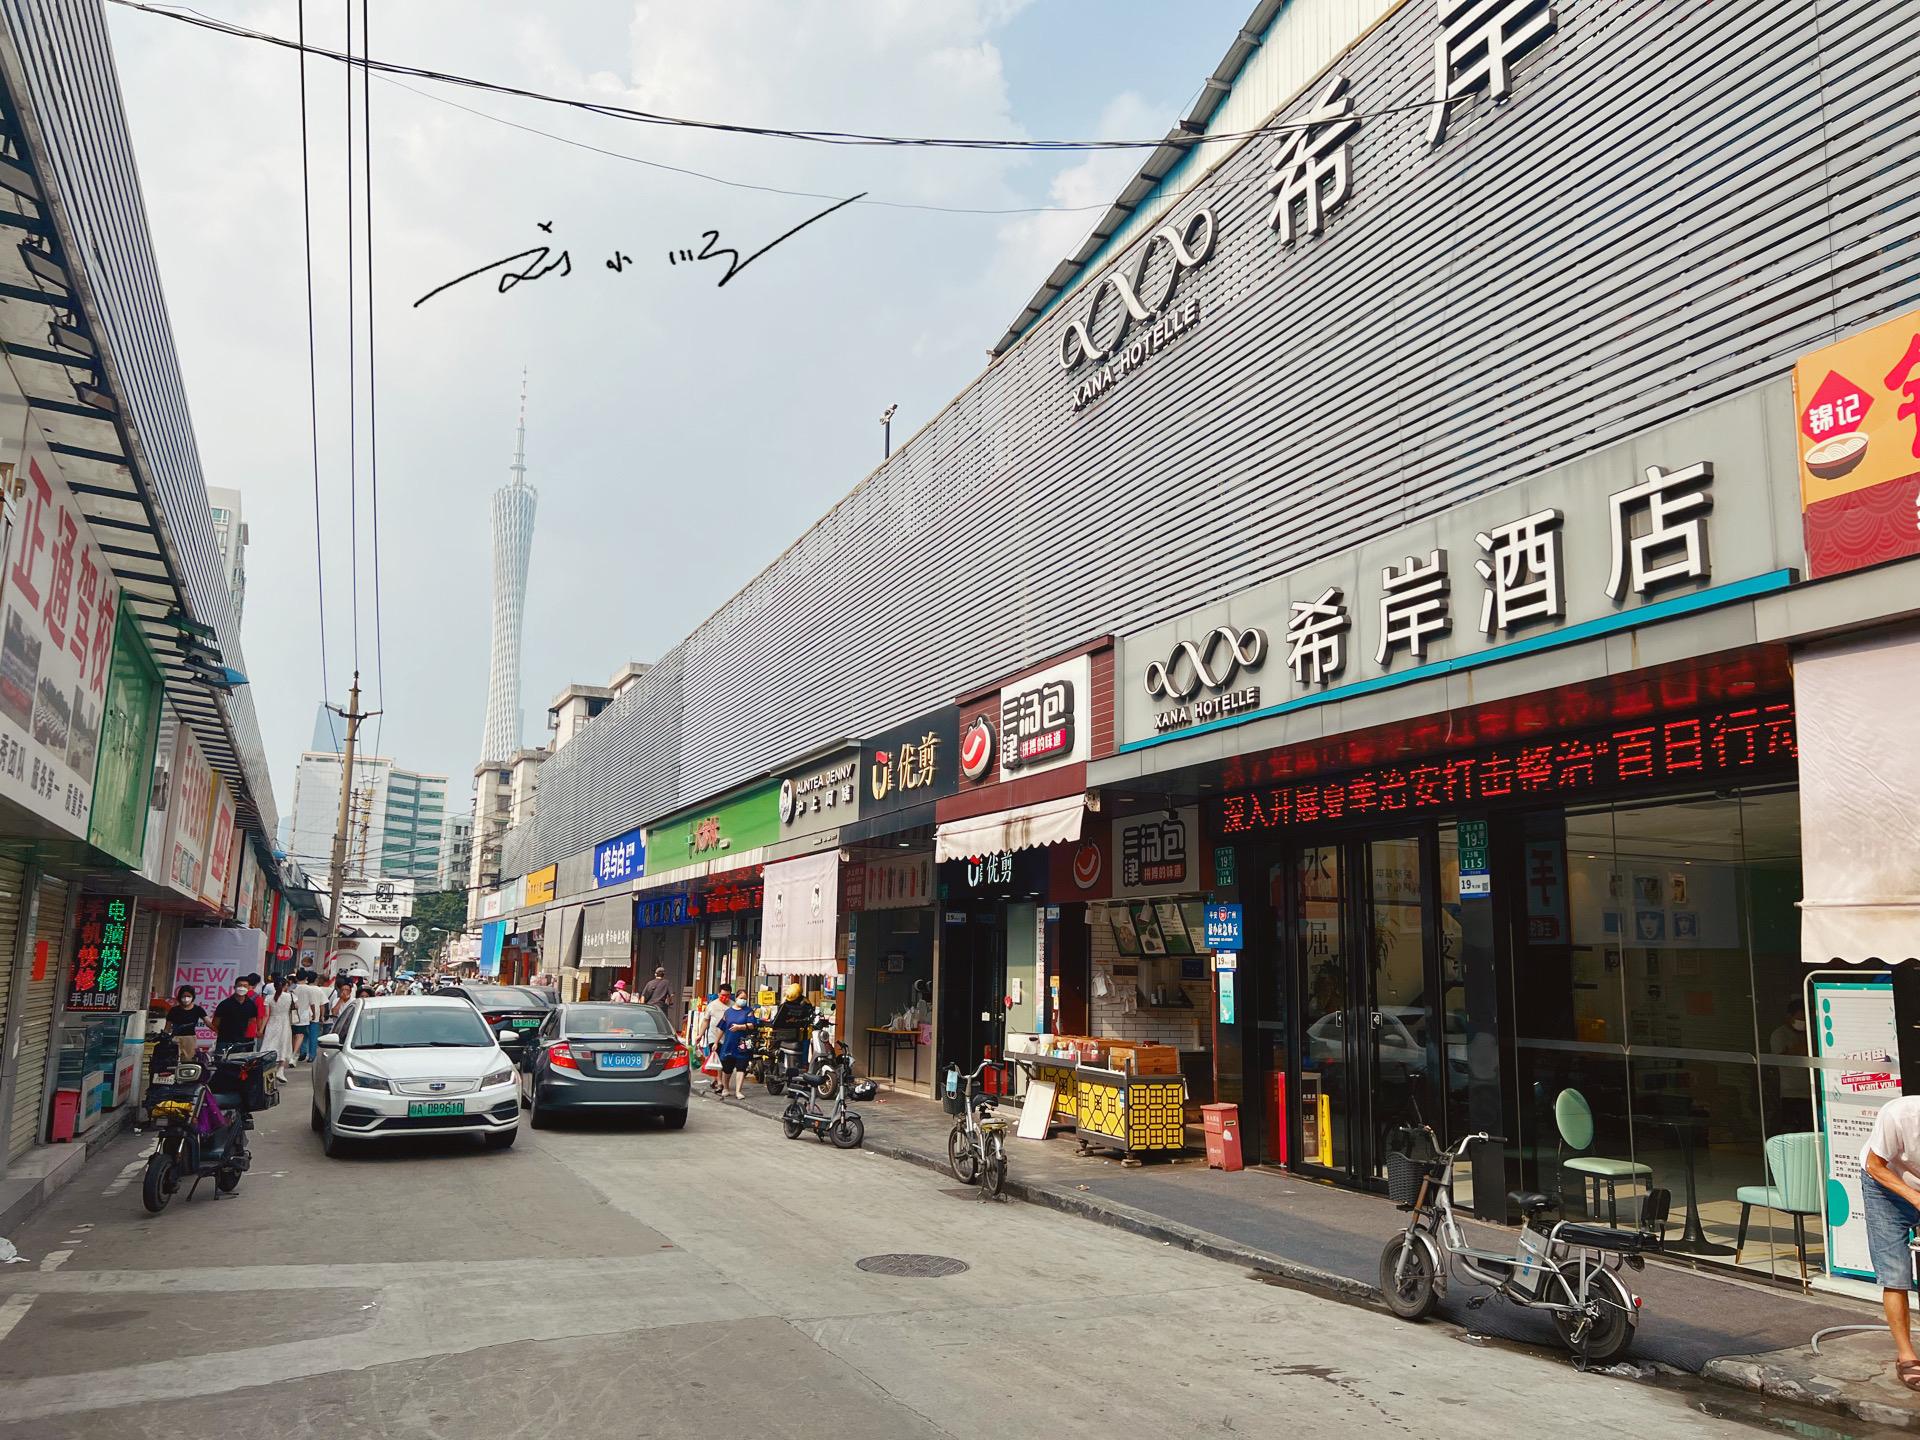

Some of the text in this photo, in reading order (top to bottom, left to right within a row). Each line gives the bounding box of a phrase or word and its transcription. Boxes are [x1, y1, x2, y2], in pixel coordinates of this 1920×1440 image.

[1071, 301, 1200, 410] XANA HOTELLE
[1809, 393, 1861, 434] 锦记
[11, 456, 115, 700] 正通驾校
[1286, 461, 1713, 684] 希岸酒店
[1154, 687, 1259, 729] XANA HOTELLE
[826, 763, 854, 785] JENNY
[897, 731, 941, 792] 优剪
[987, 850, 1013, 884] 优剪
[1464, 858, 1483, 869] 115
[1461, 880, 1472, 890] 19
[70, 992, 118, 1007] 手机回收
[1858, 1081, 1879, 1092] want
